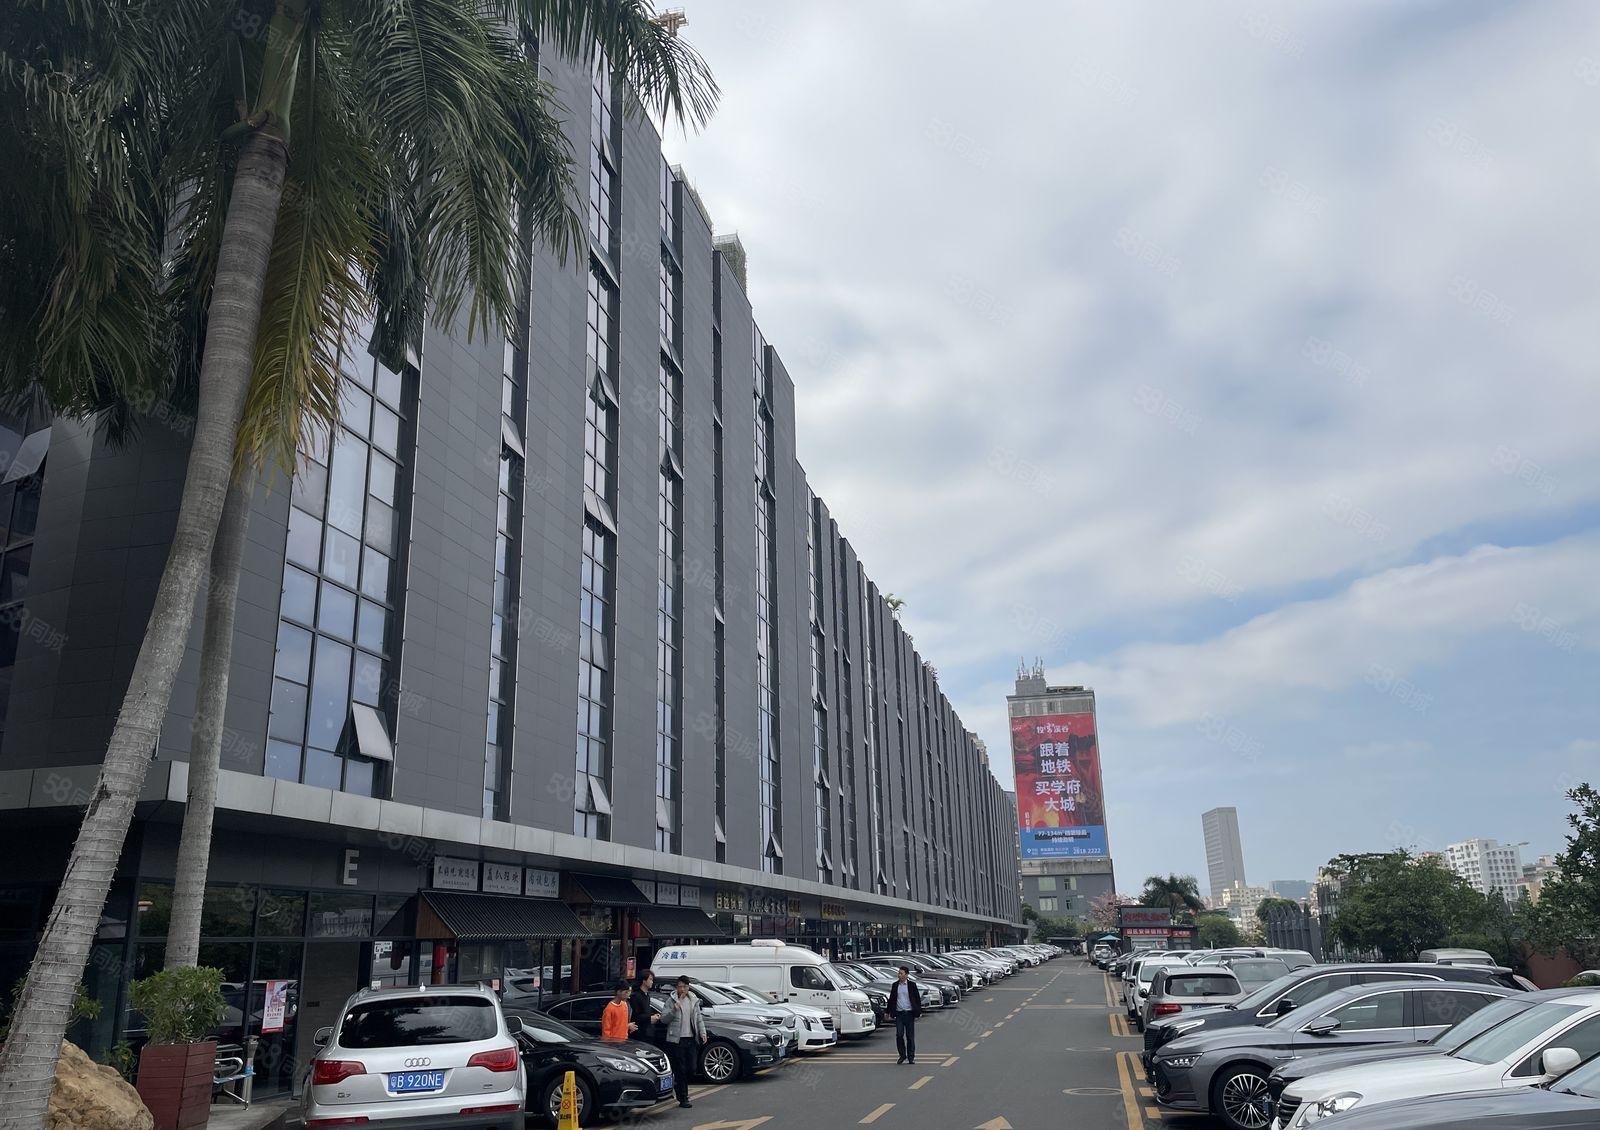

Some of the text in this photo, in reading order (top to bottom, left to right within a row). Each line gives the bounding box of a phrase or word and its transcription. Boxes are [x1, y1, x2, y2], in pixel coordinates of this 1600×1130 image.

[1040, 742, 1070, 757] 跟着
[1041, 759, 1072, 774] 地铁
[1036, 779, 1081, 795] 买学府
[1045, 797, 1076, 812] 大城
[343, 849, 360, 885] E
[661, 951, 687, 960] 冷藏车
